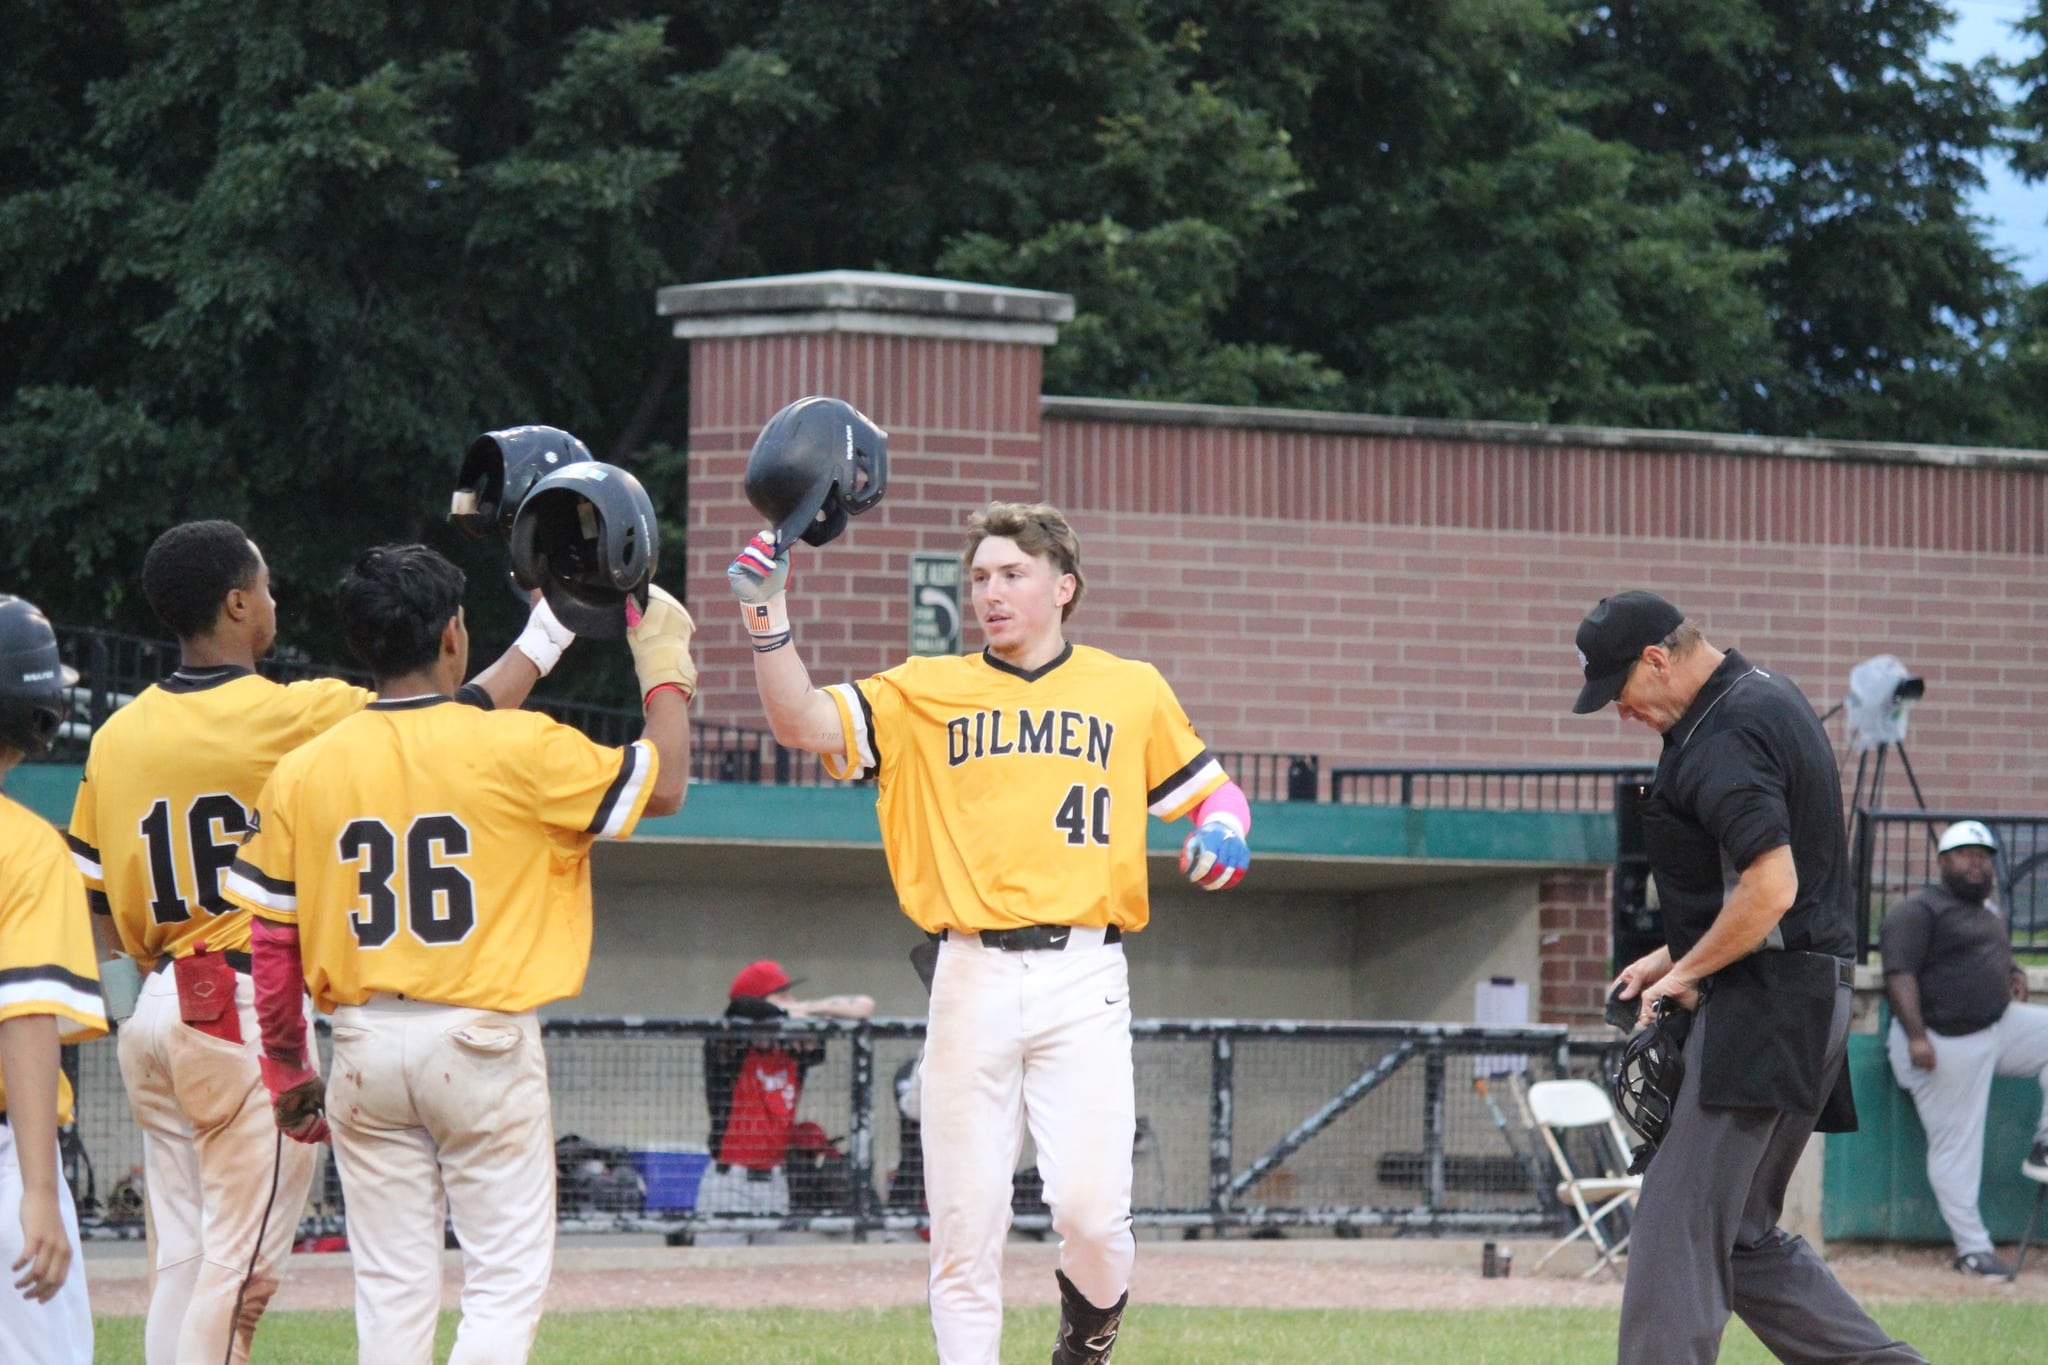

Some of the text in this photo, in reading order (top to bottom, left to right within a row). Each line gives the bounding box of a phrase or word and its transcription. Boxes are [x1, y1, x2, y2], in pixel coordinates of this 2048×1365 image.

[947, 709, 1114, 771] OILMEN
[139, 792, 250, 925] 16
[1055, 785, 1111, 846] 40
[337, 813, 477, 949] 36
